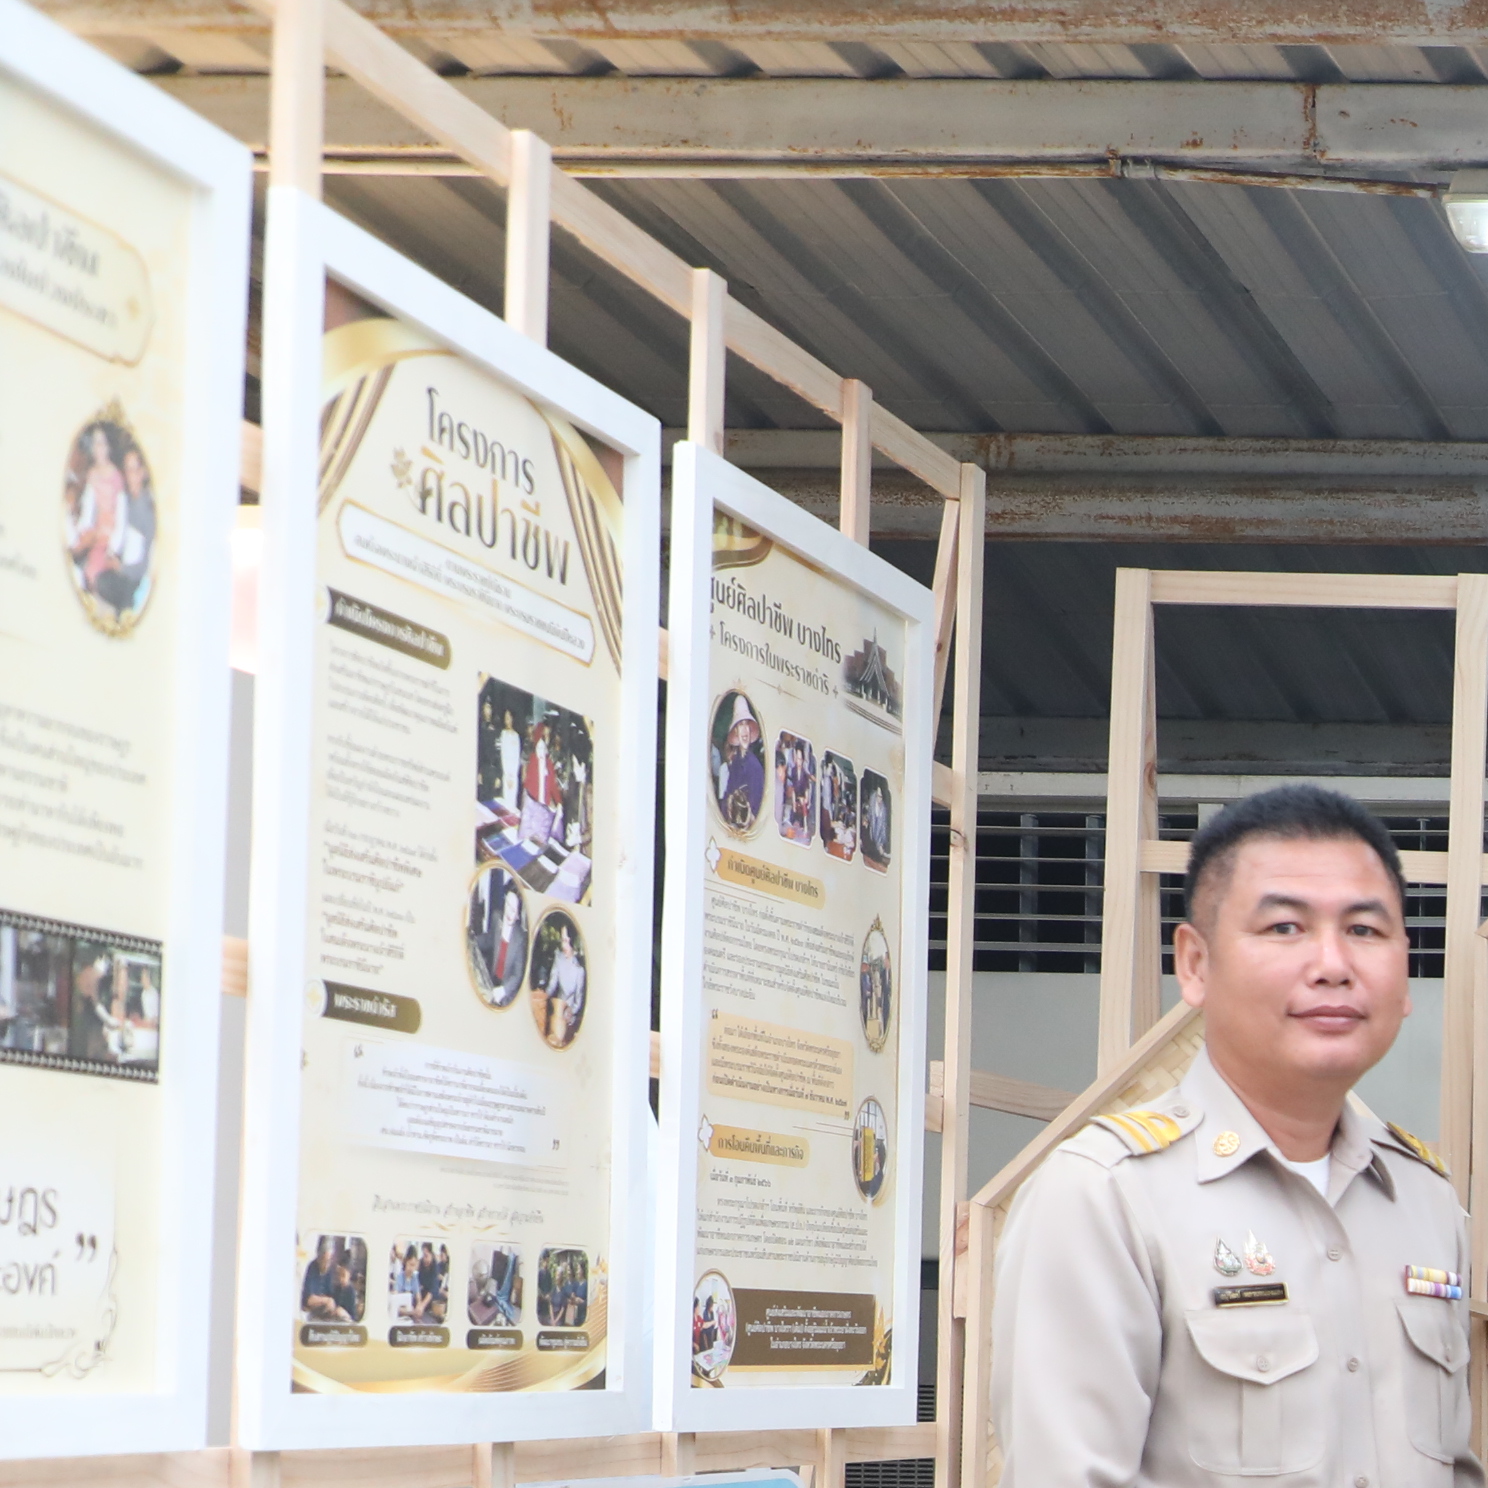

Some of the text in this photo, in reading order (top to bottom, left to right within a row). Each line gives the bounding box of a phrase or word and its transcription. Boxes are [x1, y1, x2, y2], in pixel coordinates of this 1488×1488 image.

[425, 386, 536, 496] โครงการ
[417, 444, 572, 587] ศิลปาชีพ
[719, 620, 831, 696] โครงการในพระราชดำริ
[797, 625, 842, 665] บางไทร
[0, 1249, 61, 1296] องค์
